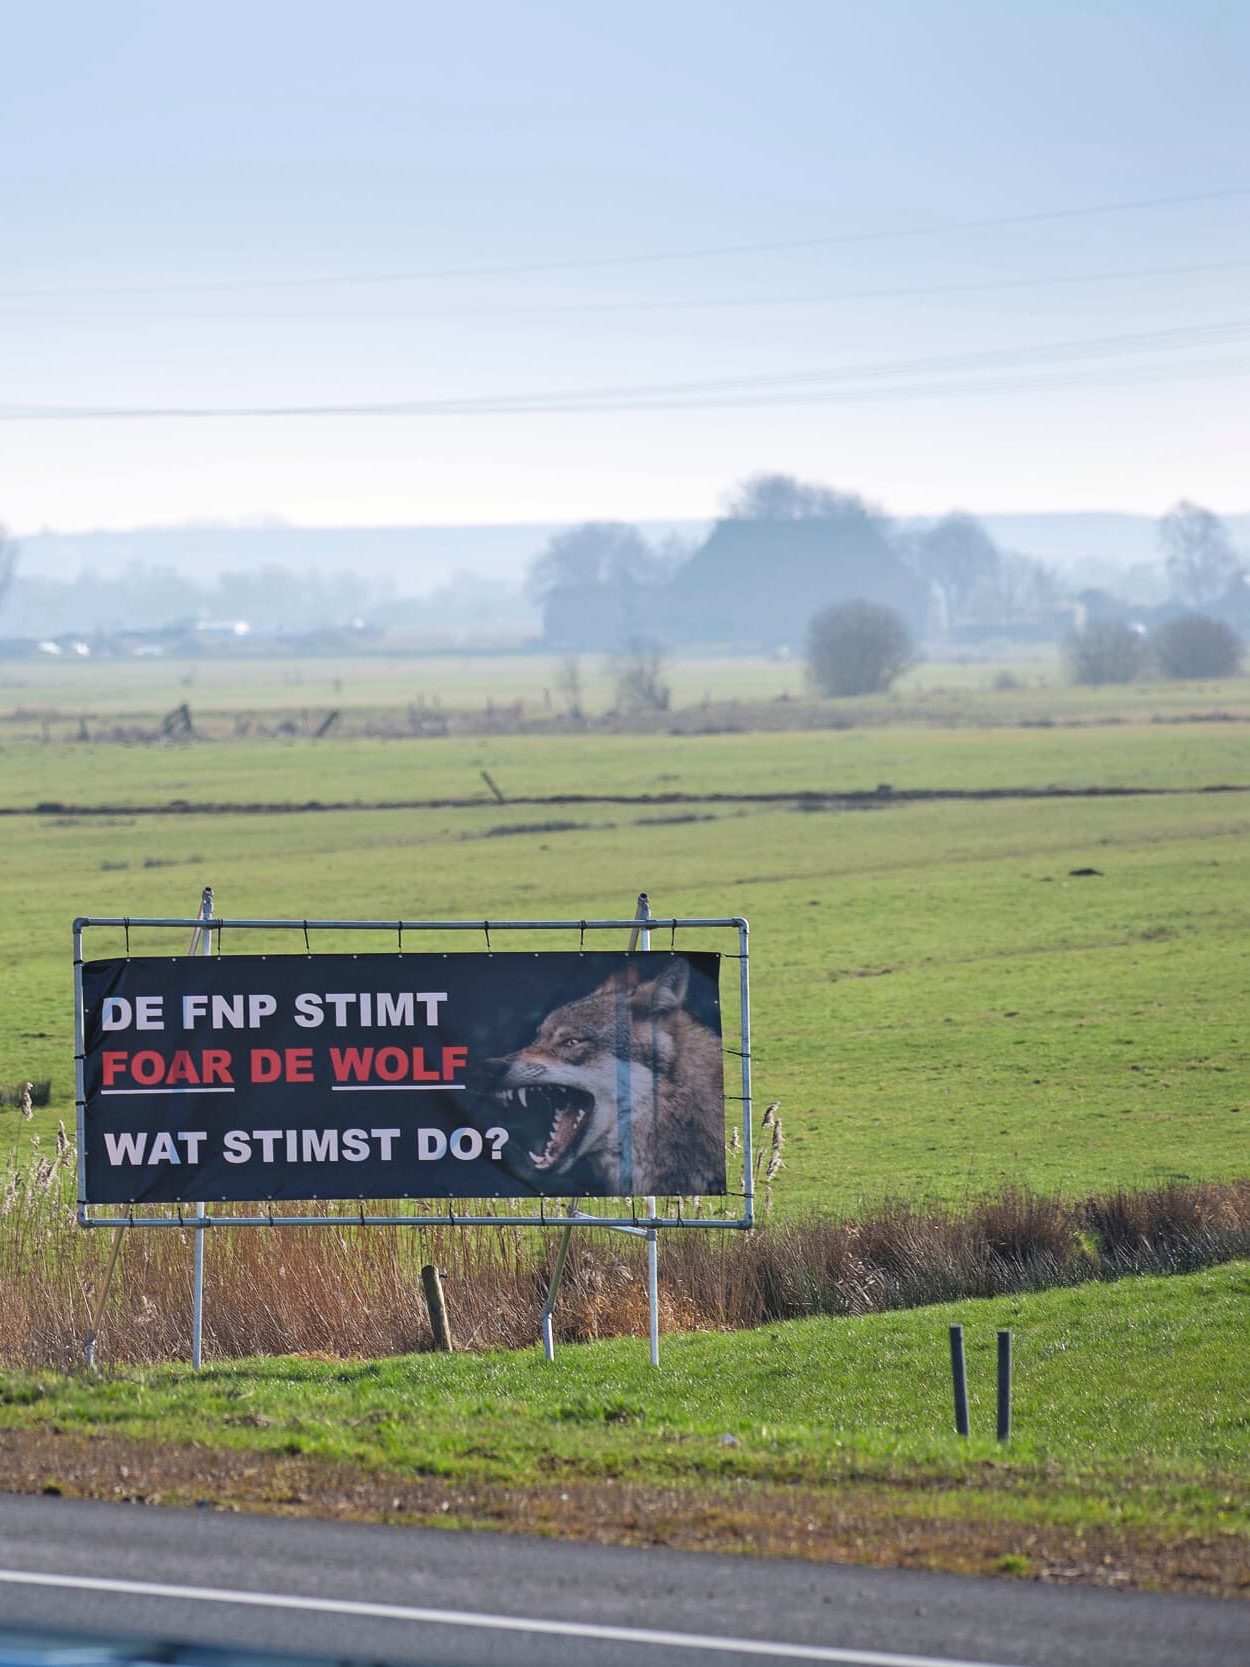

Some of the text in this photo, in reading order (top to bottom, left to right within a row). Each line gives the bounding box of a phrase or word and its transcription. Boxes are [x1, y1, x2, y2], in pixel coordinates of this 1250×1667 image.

[102, 992, 448, 1031] DE FNP STIMT
[102, 1046, 469, 1086] FOAR DE WOLF
[103, 1127, 510, 1166] WAT STIMST DO?
